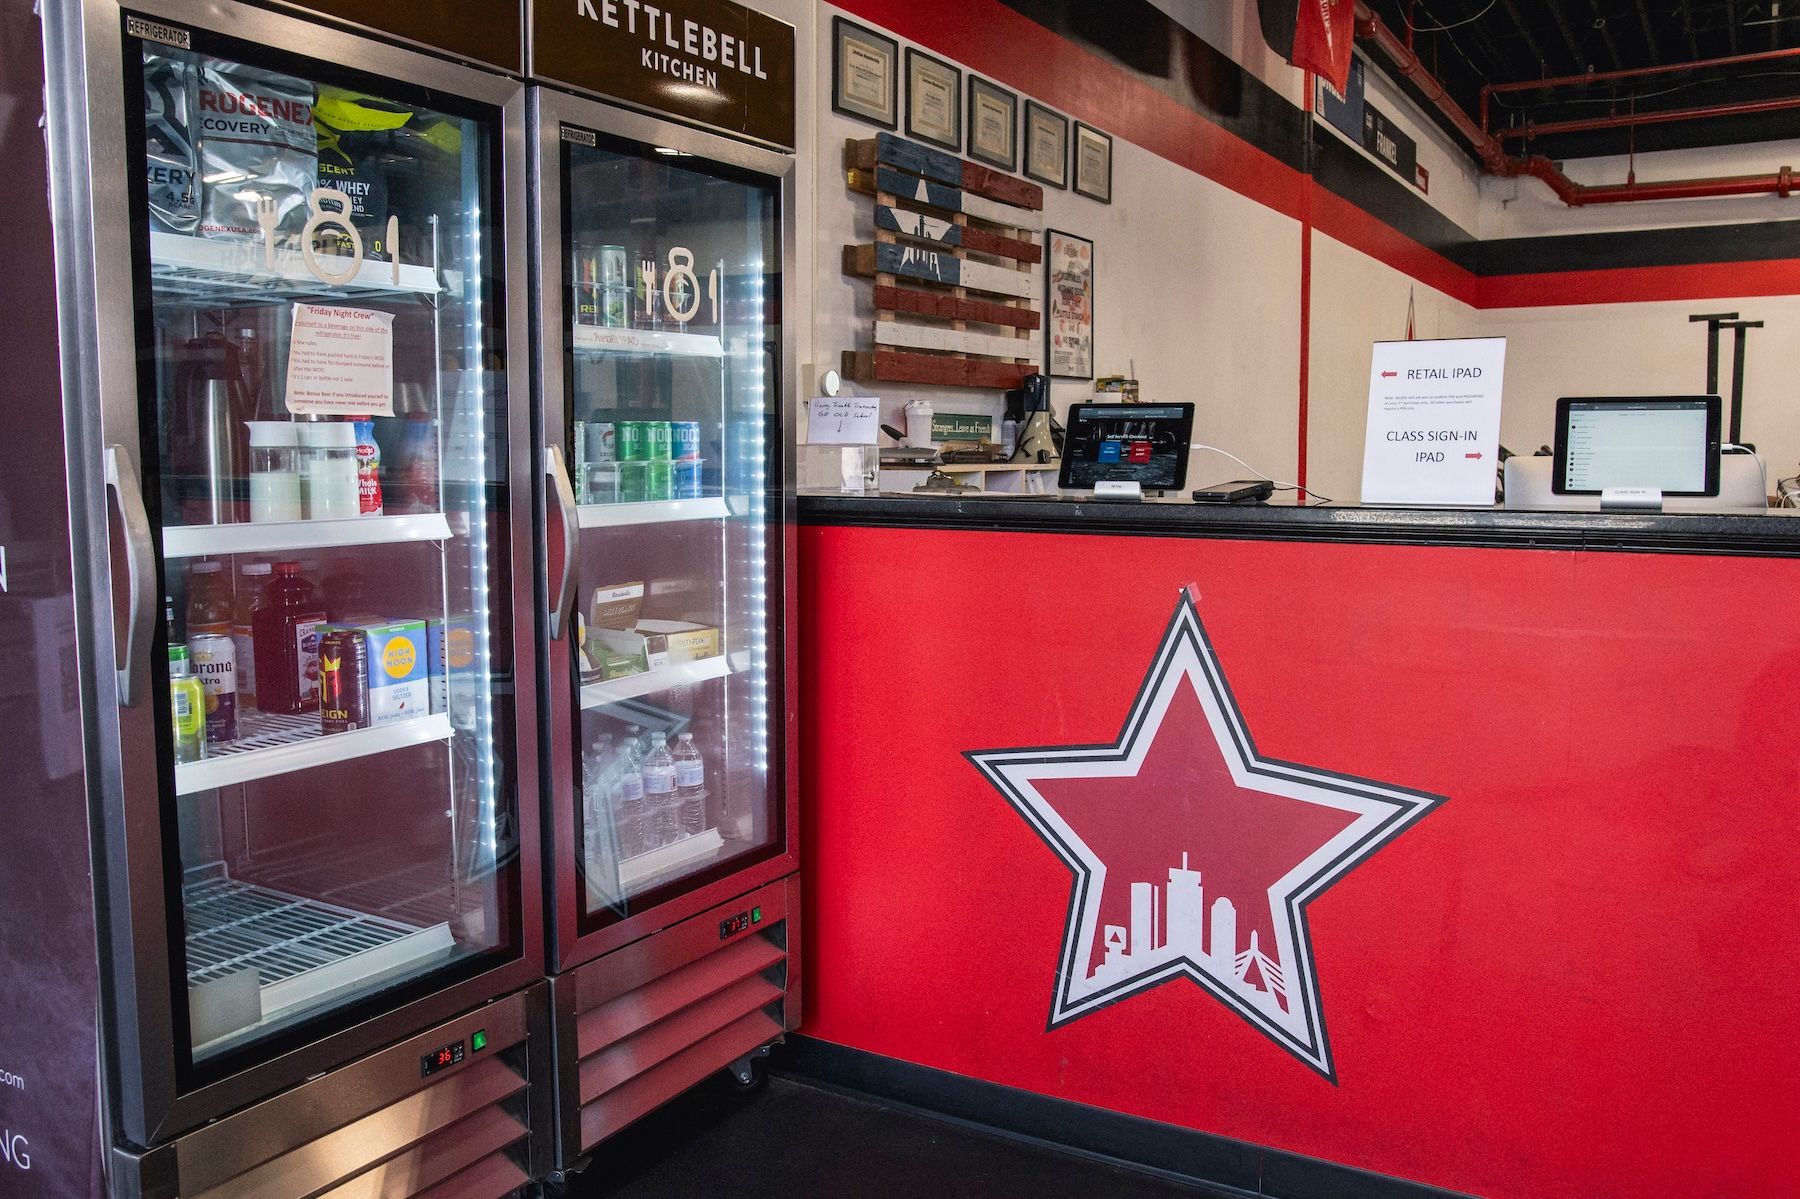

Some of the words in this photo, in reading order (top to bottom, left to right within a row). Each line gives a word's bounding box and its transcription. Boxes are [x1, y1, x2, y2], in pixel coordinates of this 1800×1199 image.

[128, 19, 189, 46] REFRIGERATOR
[577, 0, 768, 80] KETTLEBELL
[641, 47, 718, 90] KITCHEN
[336, 180, 370, 196] WHEY
[333, 309, 351, 319] Night
[1408, 368, 1448, 380] RETAIL
[1452, 368, 1482, 378] IPAD
[1386, 431, 1424, 441] CLASS
[1427, 430, 1478, 441] SIGN-IN
[1416, 452, 1445, 462] IPAD
[190, 662, 232, 673] orona
[438, 1050, 451, 1065] 36
